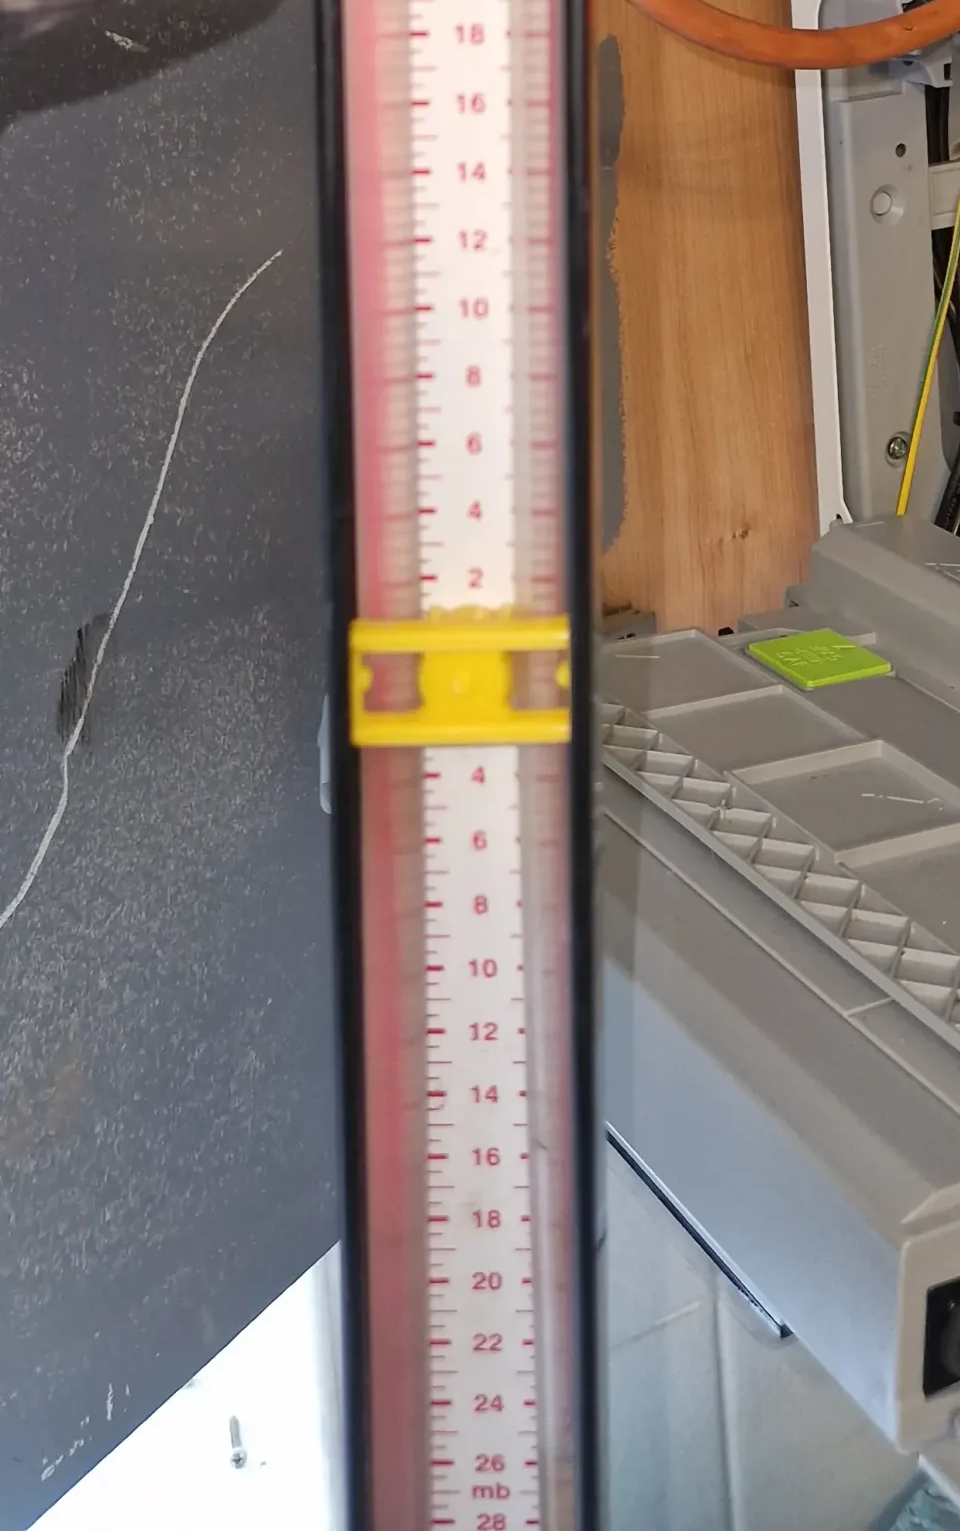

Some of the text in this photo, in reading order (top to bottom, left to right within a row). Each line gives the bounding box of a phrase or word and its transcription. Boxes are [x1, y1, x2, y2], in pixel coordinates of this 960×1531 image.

[453, 24, 485, 45] 18
[455, 93, 486, 114] 16
[456, 162, 486, 182] 14
[458, 230, 488, 250] 12
[458, 299, 488, 319] 10
[466, 366, 481, 387] 8
[466, 433, 481, 454] 6
[466, 501, 482, 521] 4
[467, 568, 483, 588] 2
[470, 766, 486, 786] 4
[472, 830, 487, 851] 6
[473, 896, 488, 915] 8
[468, 959, 498, 979] 10
[468, 1022, 499, 1043] 12
[469, 1085, 500, 1104] 14
[471, 1147, 501, 1167] 16
[471, 1209, 502, 1229] 18
[471, 1272, 503, 1291] 20
[472, 1333, 504, 1352] 22
[473, 1394, 505, 1414] 24
[474, 1454, 506, 1473] 26
[471, 1483, 510, 1501] mb
[476, 1513, 508, 1531] 28
